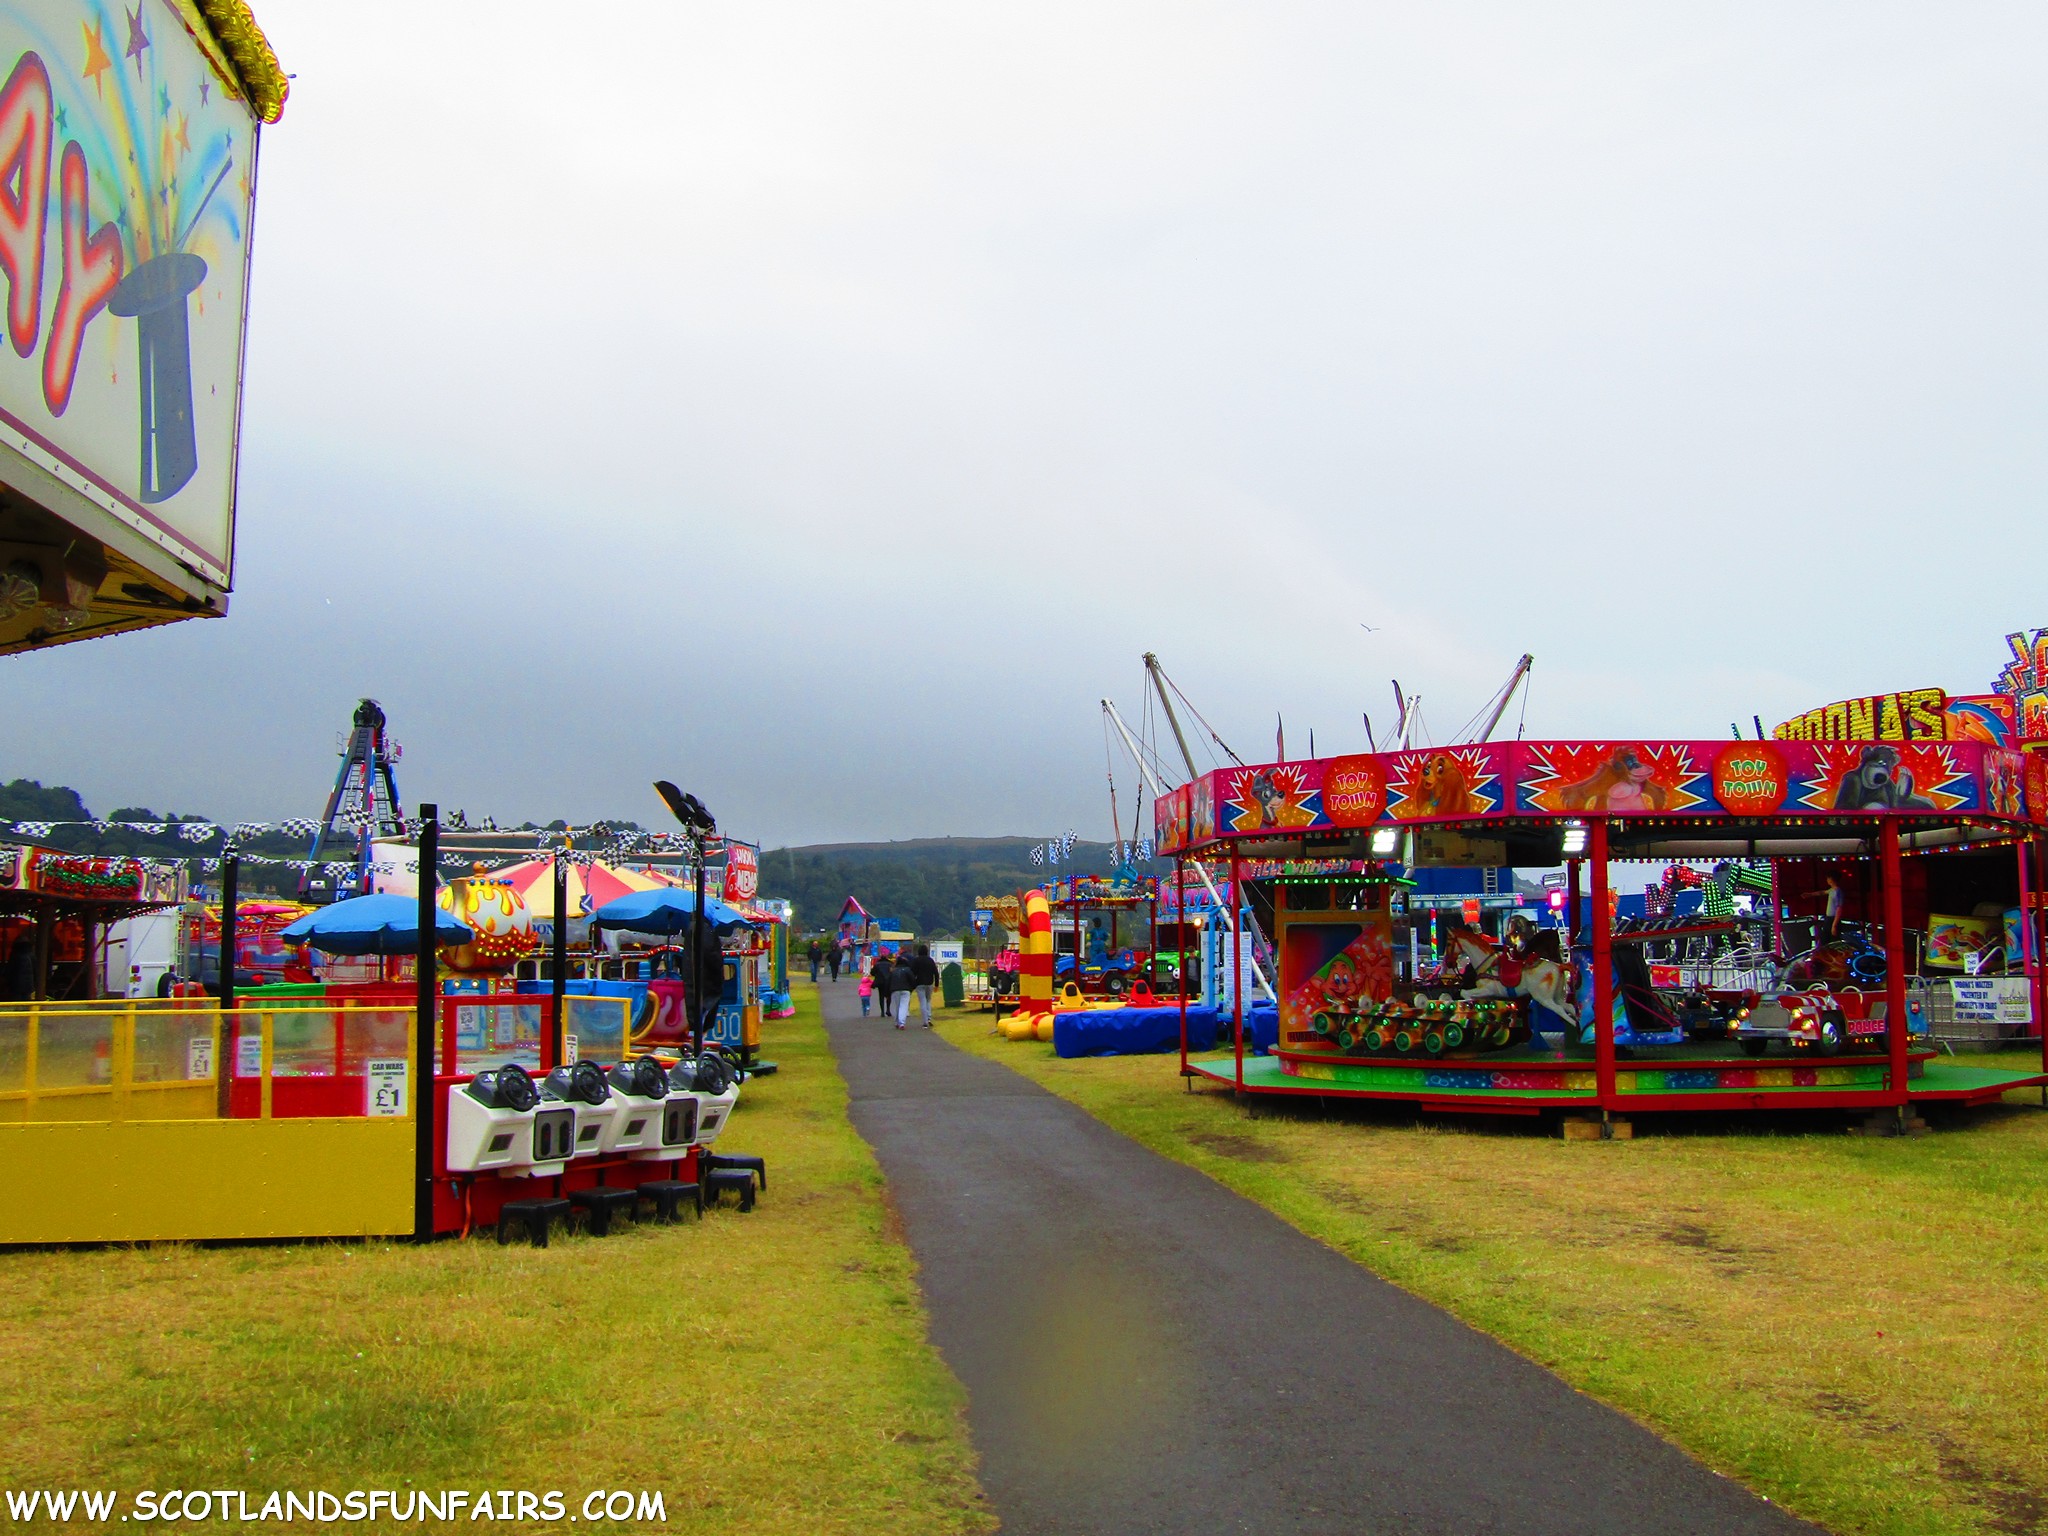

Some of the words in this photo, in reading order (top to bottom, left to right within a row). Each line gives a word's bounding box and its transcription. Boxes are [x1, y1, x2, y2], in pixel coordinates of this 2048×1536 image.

[1730, 759, 1767, 777] TOY
[1336, 772, 1368, 790] TOY
[1723, 780, 1777, 798] TOWN
[1330, 791, 1377, 810] TOWN
[941, 950, 957, 958] TOKENS
[1848, 1019, 1886, 1035] POLICE
[372, 1063, 385, 1071] CAR
[376, 1088, 399, 1107] £1
